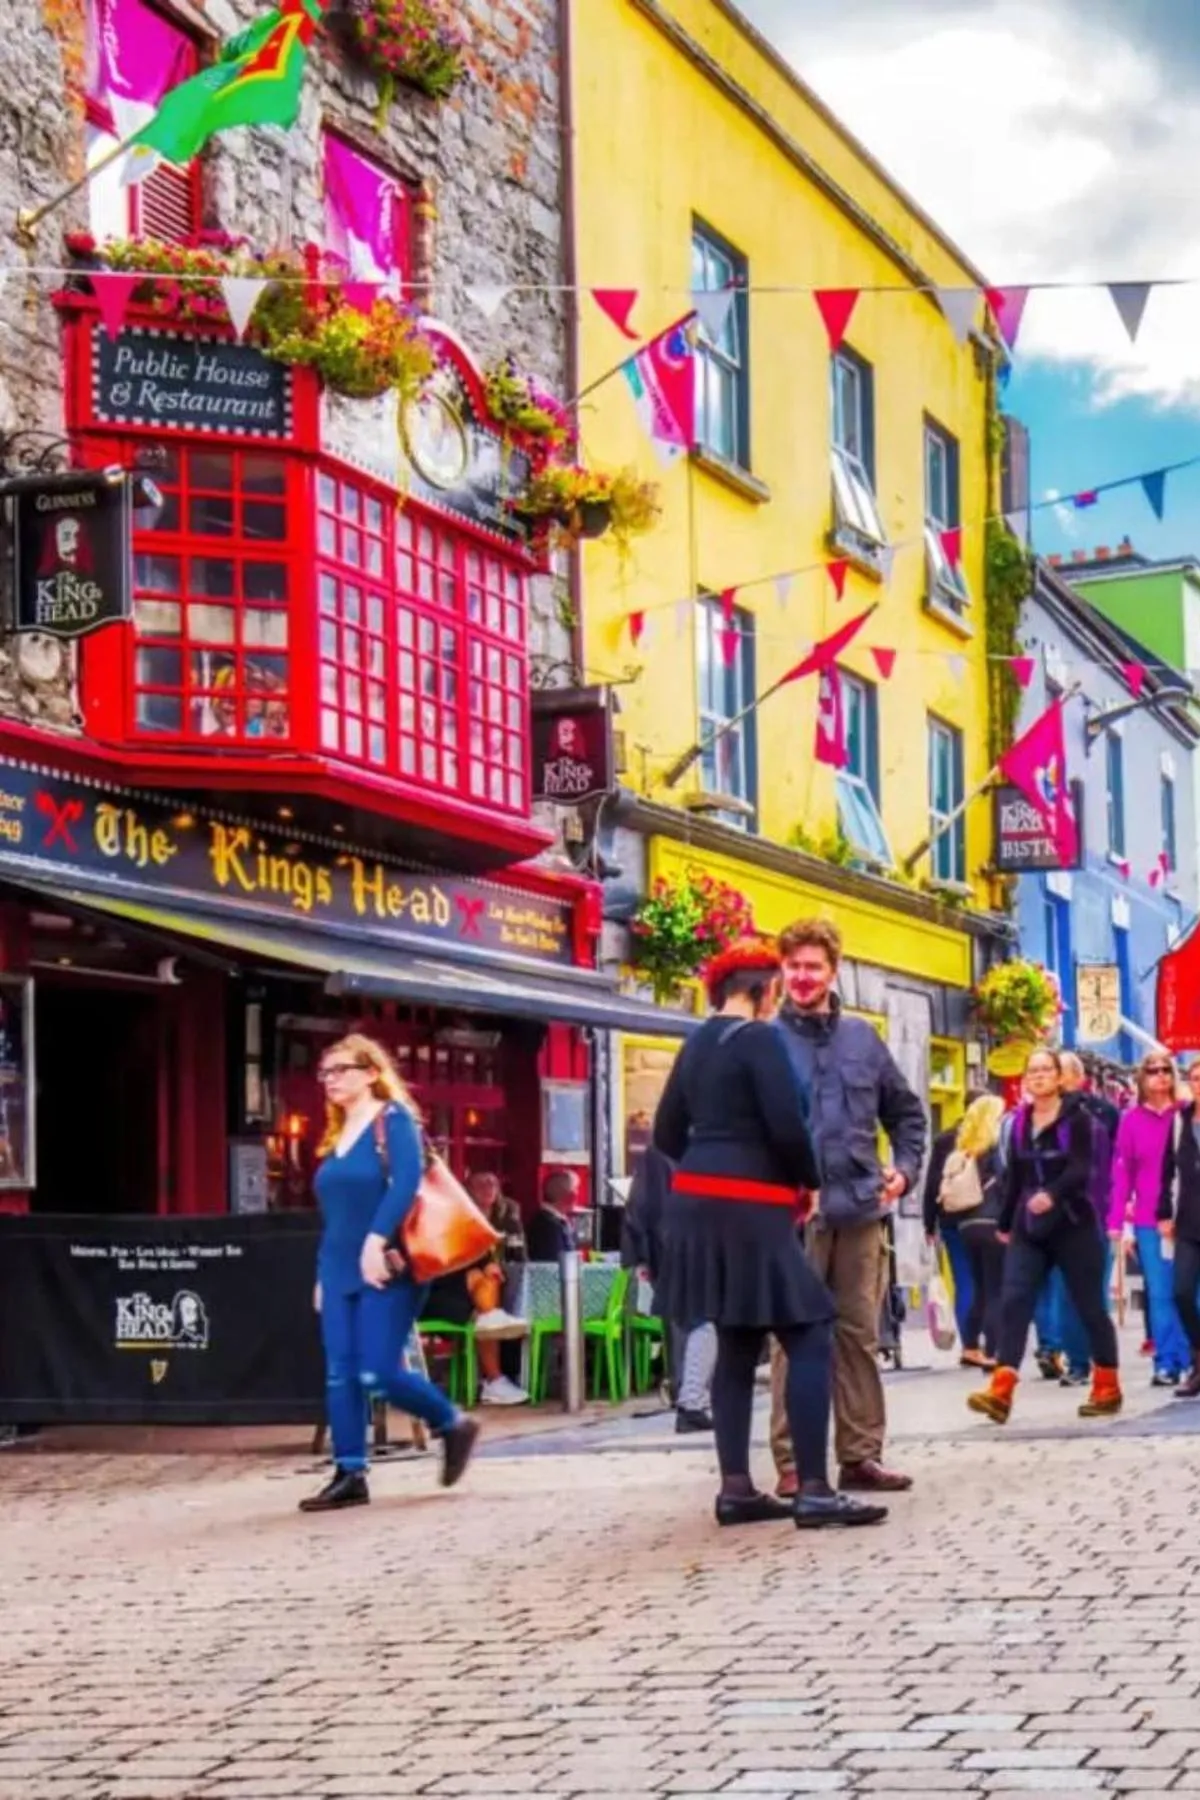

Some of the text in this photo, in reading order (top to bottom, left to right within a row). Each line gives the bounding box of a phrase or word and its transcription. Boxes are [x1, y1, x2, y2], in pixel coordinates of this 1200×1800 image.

[114, 346, 271, 389] Public House
[109, 379, 277, 419] & Restaurant
[36, 601, 98, 625] HEAD
[94, 801, 178, 869] The
[208, 820, 333, 914] Kings
[336, 854, 450, 928] Head
